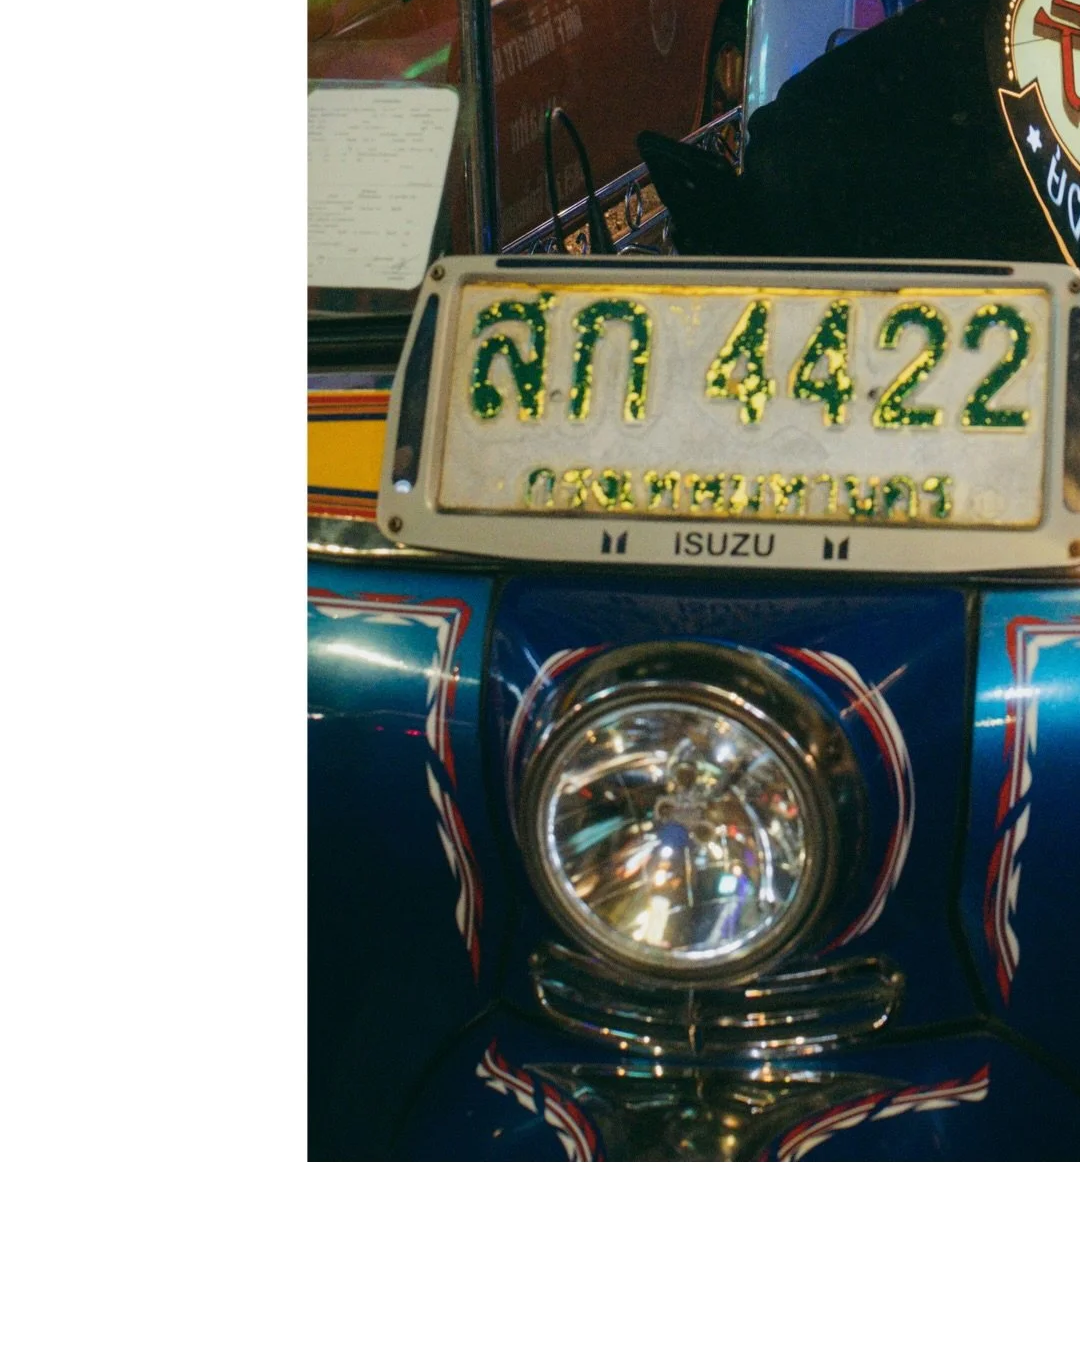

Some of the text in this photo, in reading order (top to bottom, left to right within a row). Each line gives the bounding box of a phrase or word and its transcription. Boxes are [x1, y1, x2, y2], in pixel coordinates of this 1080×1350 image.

[471, 292, 1031, 429] สก 4422
[524, 465, 954, 519] กรงเทพมหานคร
[673, 531, 776, 558] ISUZU
